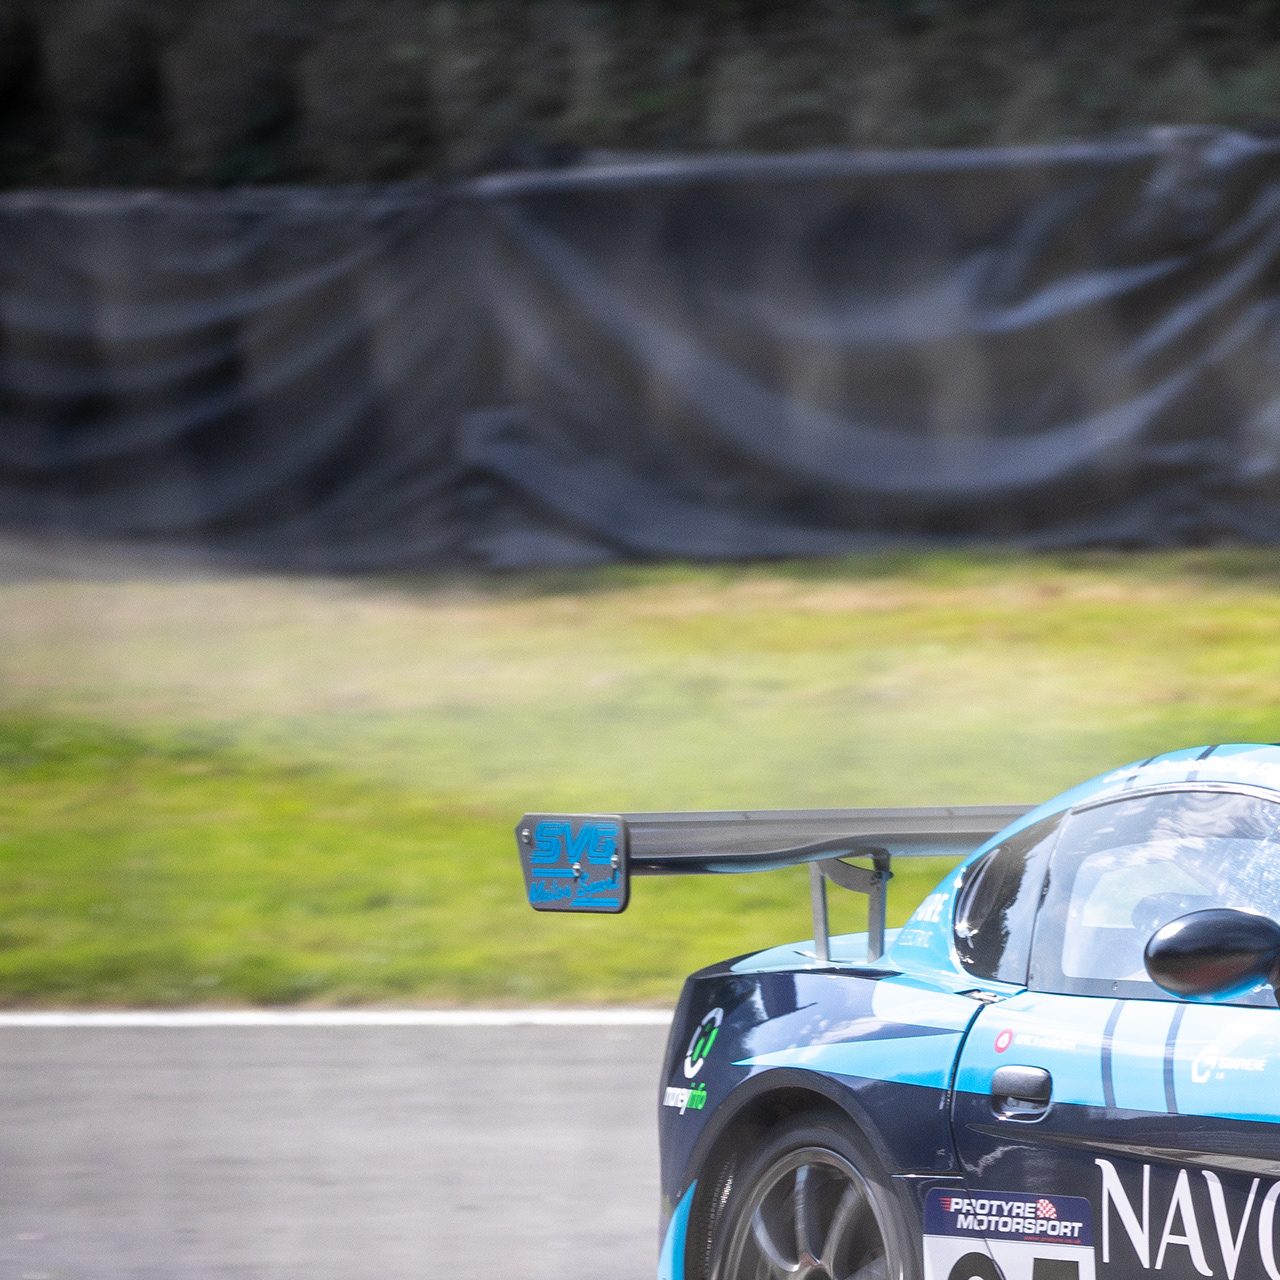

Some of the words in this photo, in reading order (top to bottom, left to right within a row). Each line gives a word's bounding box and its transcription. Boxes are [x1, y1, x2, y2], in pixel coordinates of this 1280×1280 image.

[528, 819, 620, 865] SVG
[950, 1197, 1037, 1218] PROTYRE
[956, 1214, 1083, 1237] MOTORSPORT
